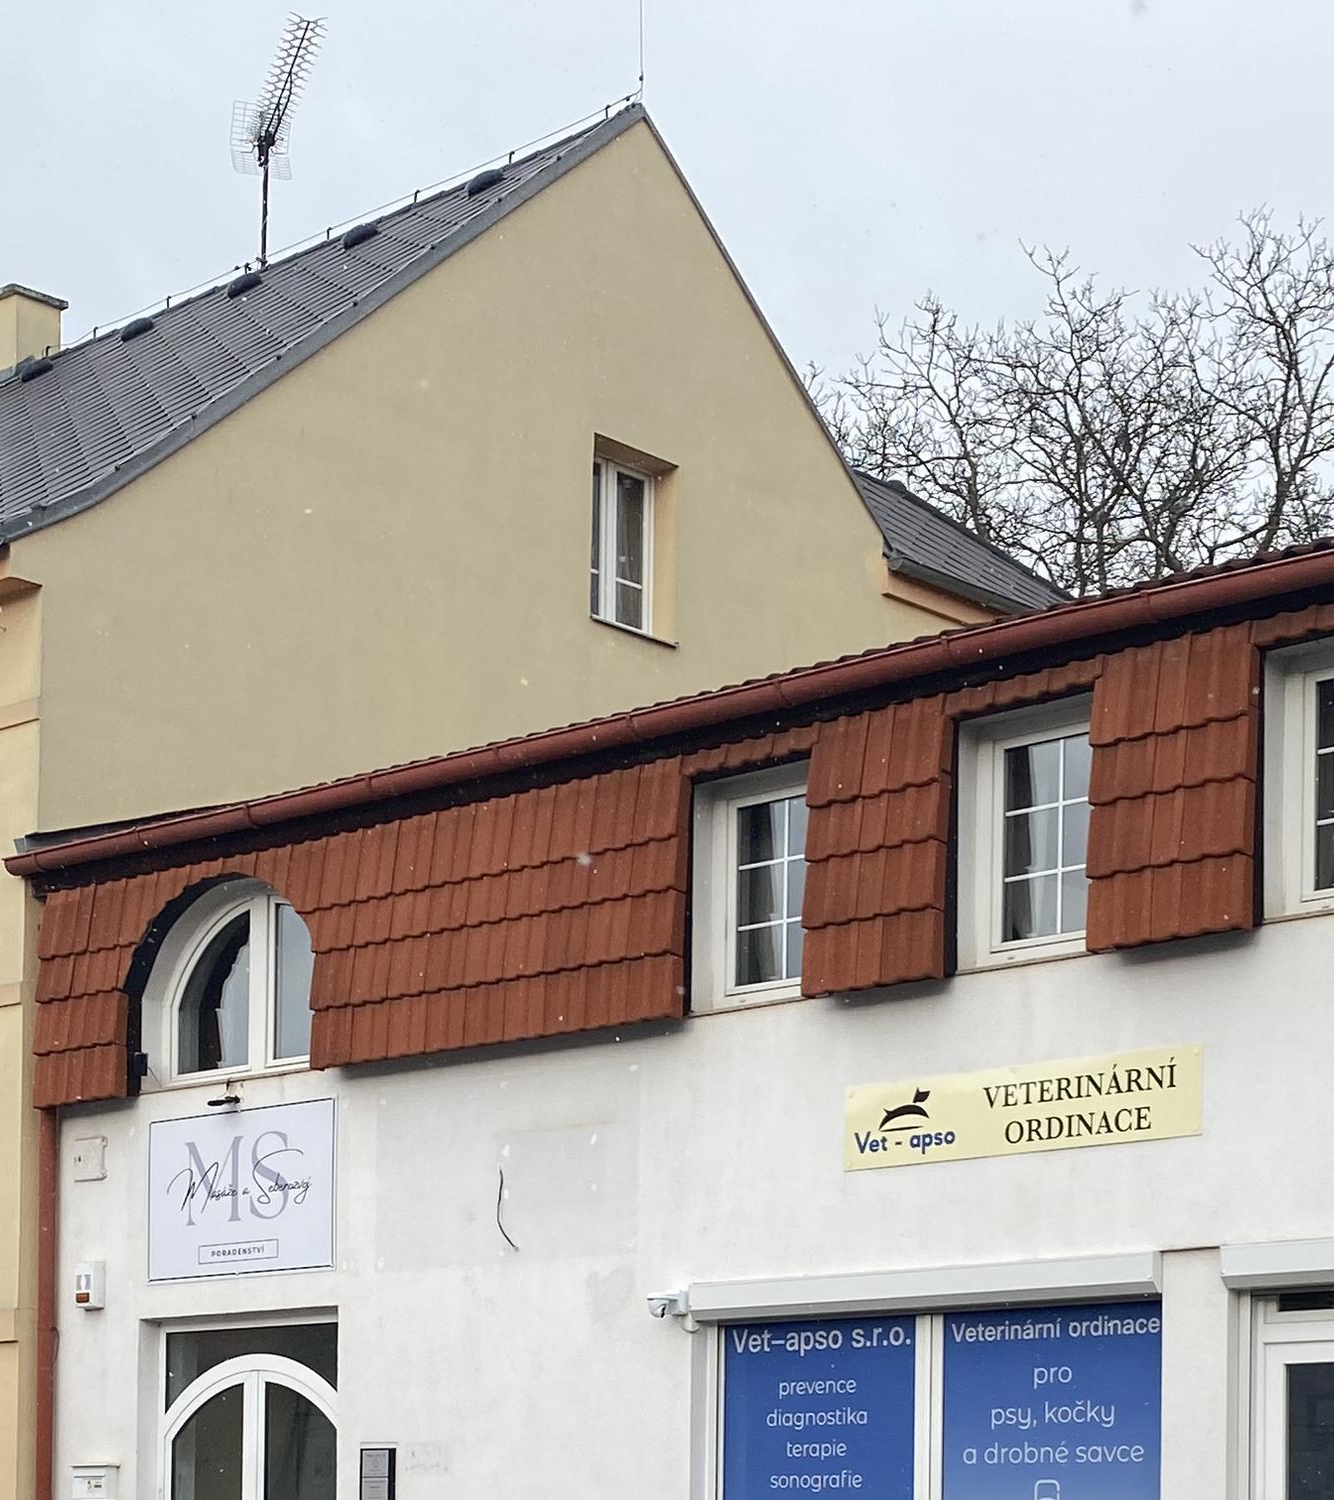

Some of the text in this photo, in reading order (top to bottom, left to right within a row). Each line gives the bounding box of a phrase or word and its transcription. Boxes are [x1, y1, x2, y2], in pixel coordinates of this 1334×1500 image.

[983, 1057, 1177, 1109] VETERINÁRNÍ
[1004, 1106, 1152, 1144] ORDINACE
[854, 1131, 888, 1154] Vet
[909, 1130, 956, 1155] apso
[210, 1244, 266, 1258] PORADENSTVÍ
[851, 1326, 912, 1348] s.r.o.
[952, 1316, 1161, 1343] Veterinární ordinace
[1033, 1366, 1072, 1389] pro
[778, 1379, 857, 1400] prevence
[766, 1407, 868, 1430] diagnostika
[991, 1400, 1115, 1430] psy, kočky
[786, 1440, 847, 1461] terapie
[963, 1441, 1144, 1464] a drobné savce
[770, 1470, 863, 1492] sonografie
